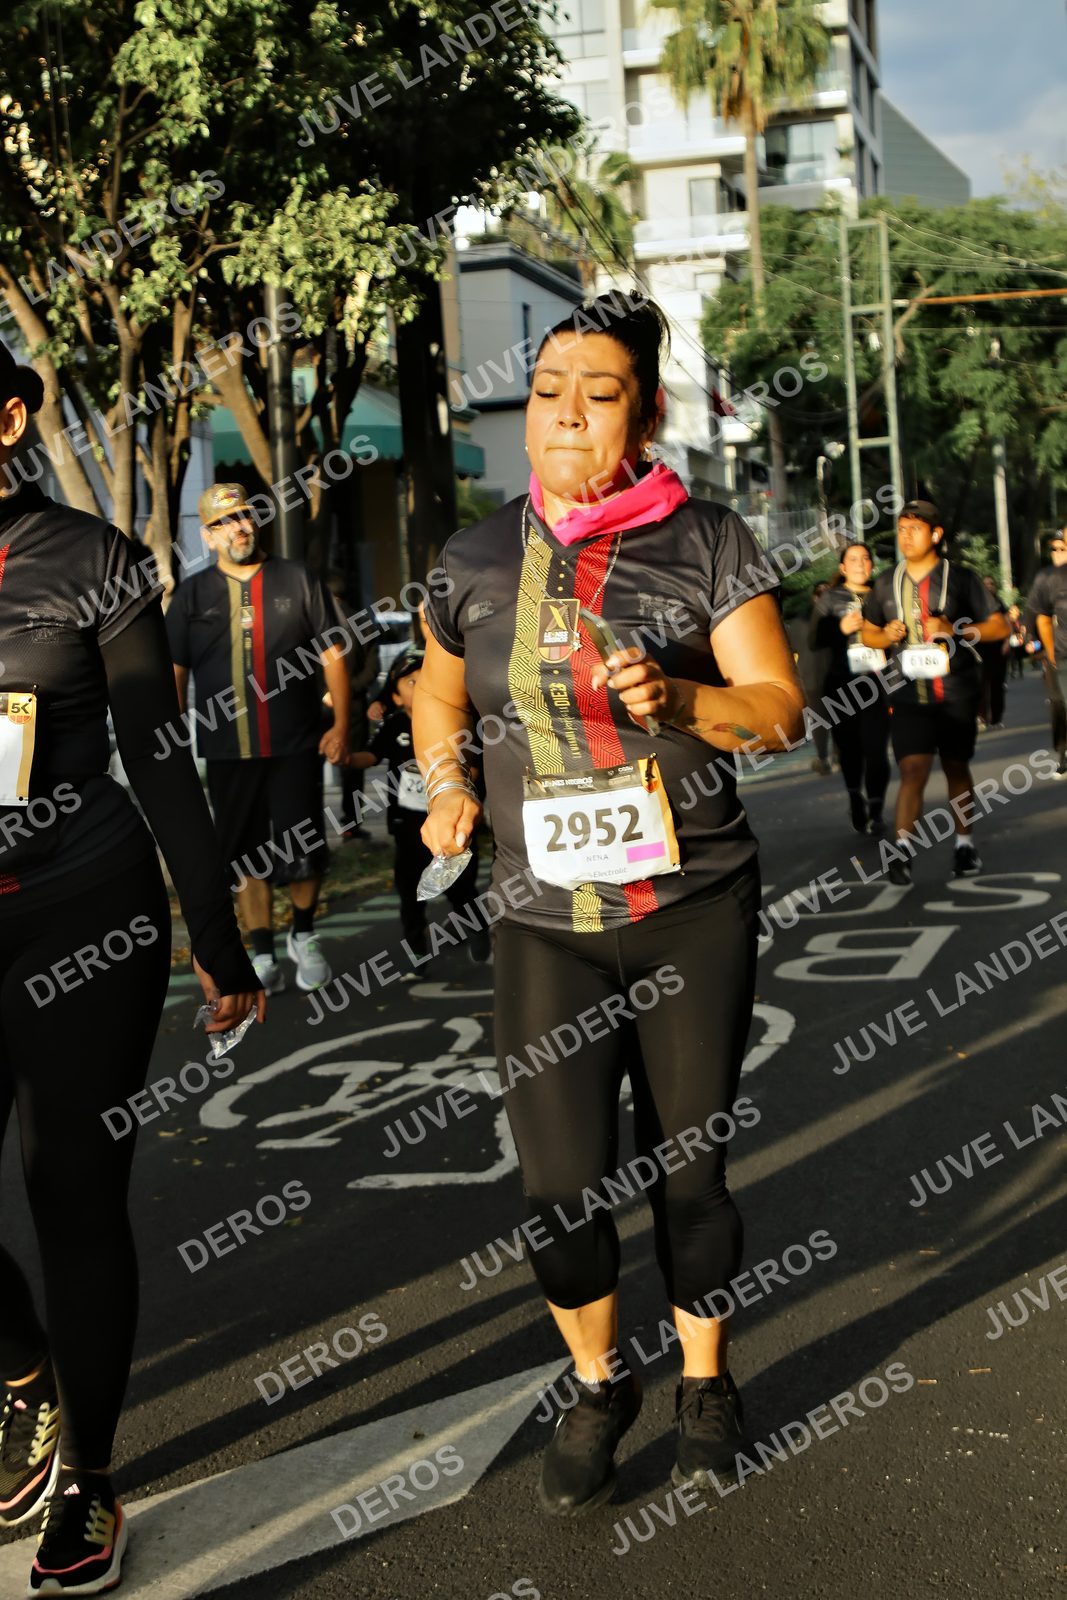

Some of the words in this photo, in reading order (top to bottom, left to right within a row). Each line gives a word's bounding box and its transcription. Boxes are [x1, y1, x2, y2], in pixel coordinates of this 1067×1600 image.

[11, 702, 30, 715] 5K
[543, 804, 644, 853] 2952
[586, 854, 609, 862] NENA
